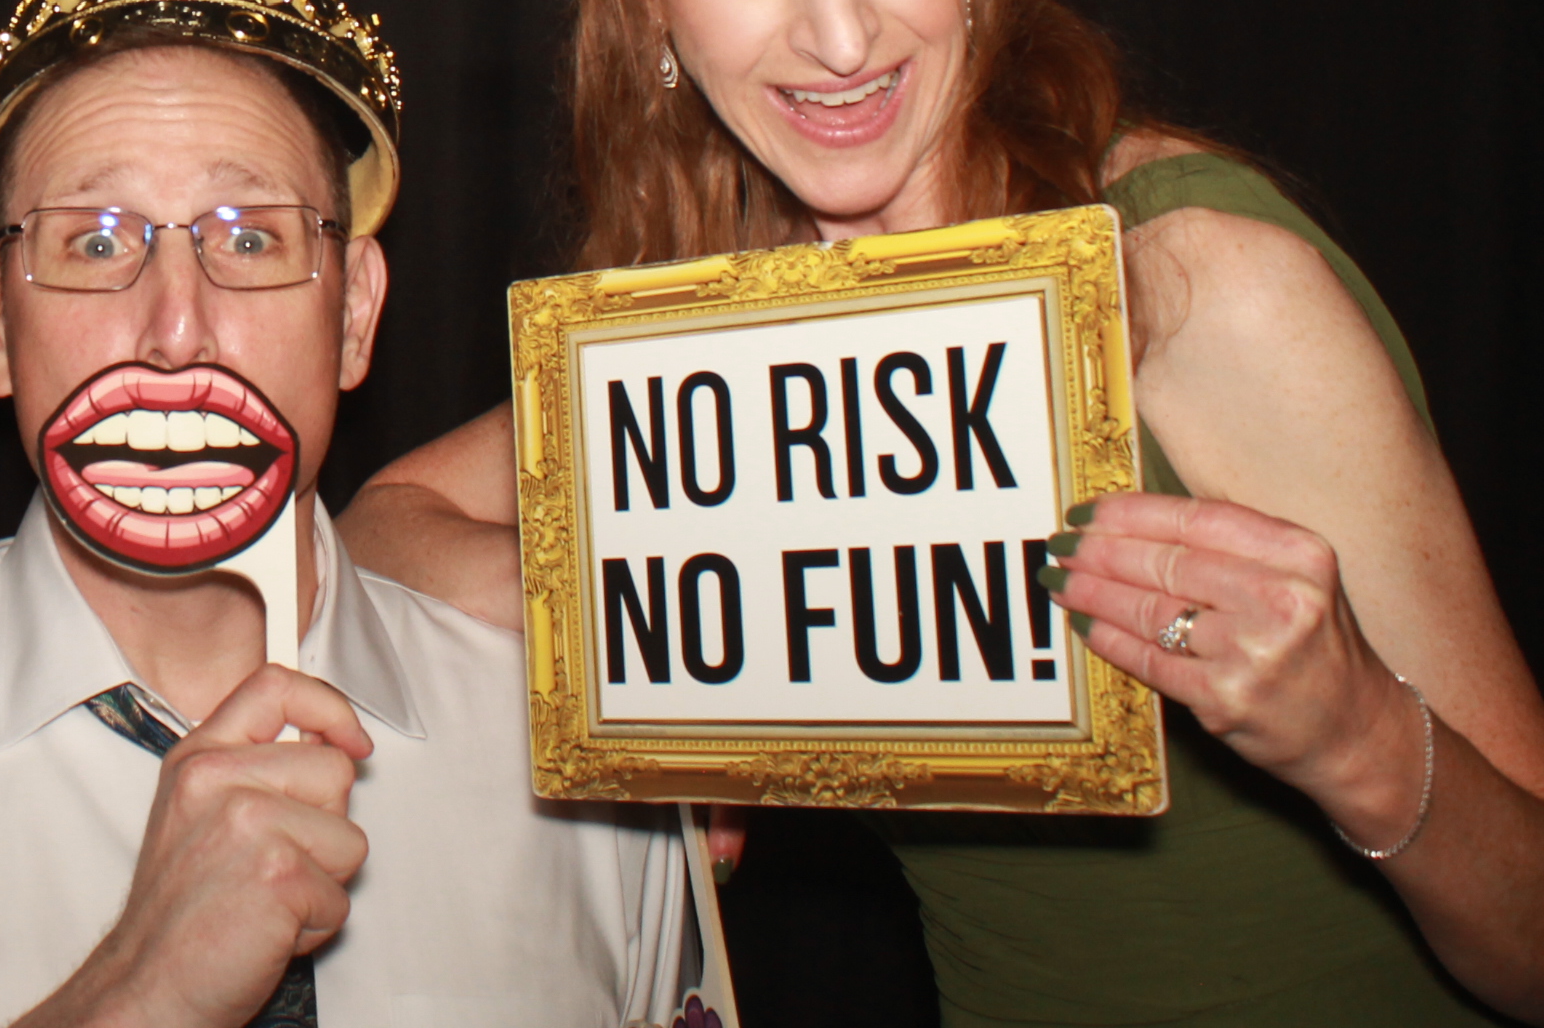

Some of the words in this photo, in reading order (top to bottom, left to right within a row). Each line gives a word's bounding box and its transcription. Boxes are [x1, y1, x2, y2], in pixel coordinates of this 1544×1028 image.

[608, 371, 736, 512] NO
[769, 342, 1018, 502] RISK
[602, 552, 745, 685] NO
[781, 539, 1057, 684] FUN!
